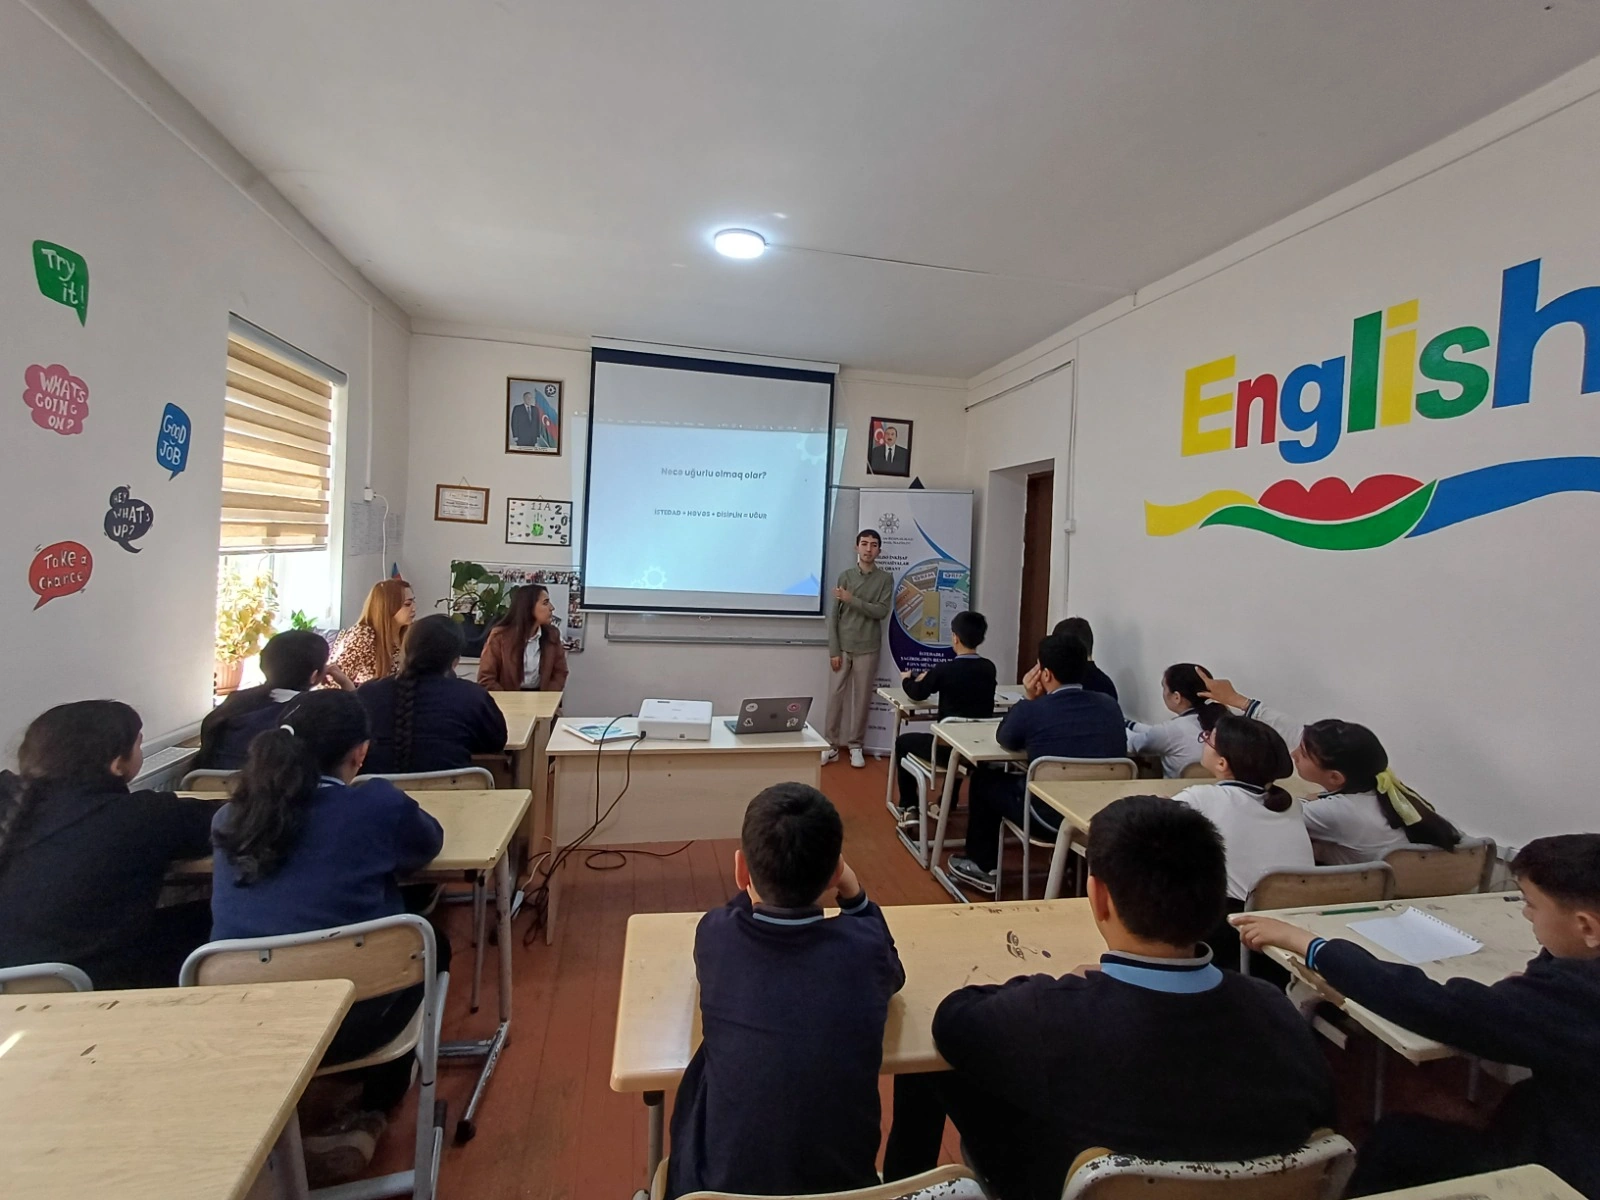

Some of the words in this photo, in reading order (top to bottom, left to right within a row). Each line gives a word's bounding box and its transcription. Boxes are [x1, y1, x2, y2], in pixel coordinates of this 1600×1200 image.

[41, 248, 75, 281] Try
[62, 281, 84, 309] it!
[1180, 257, 1600, 464] English
[35, 392, 78, 416] GOING
[48, 415, 75, 432] ON?
[163, 414, 187, 444] GOOD
[160, 440, 181, 465] JOB
[684, 468, 713, 479] uğurlu
[715, 470, 743, 480] olmaq
[744, 471, 767, 480] olar?
[113, 524, 135, 539] UP?
[43, 550, 76, 569] Take
[80, 555, 87, 564] a
